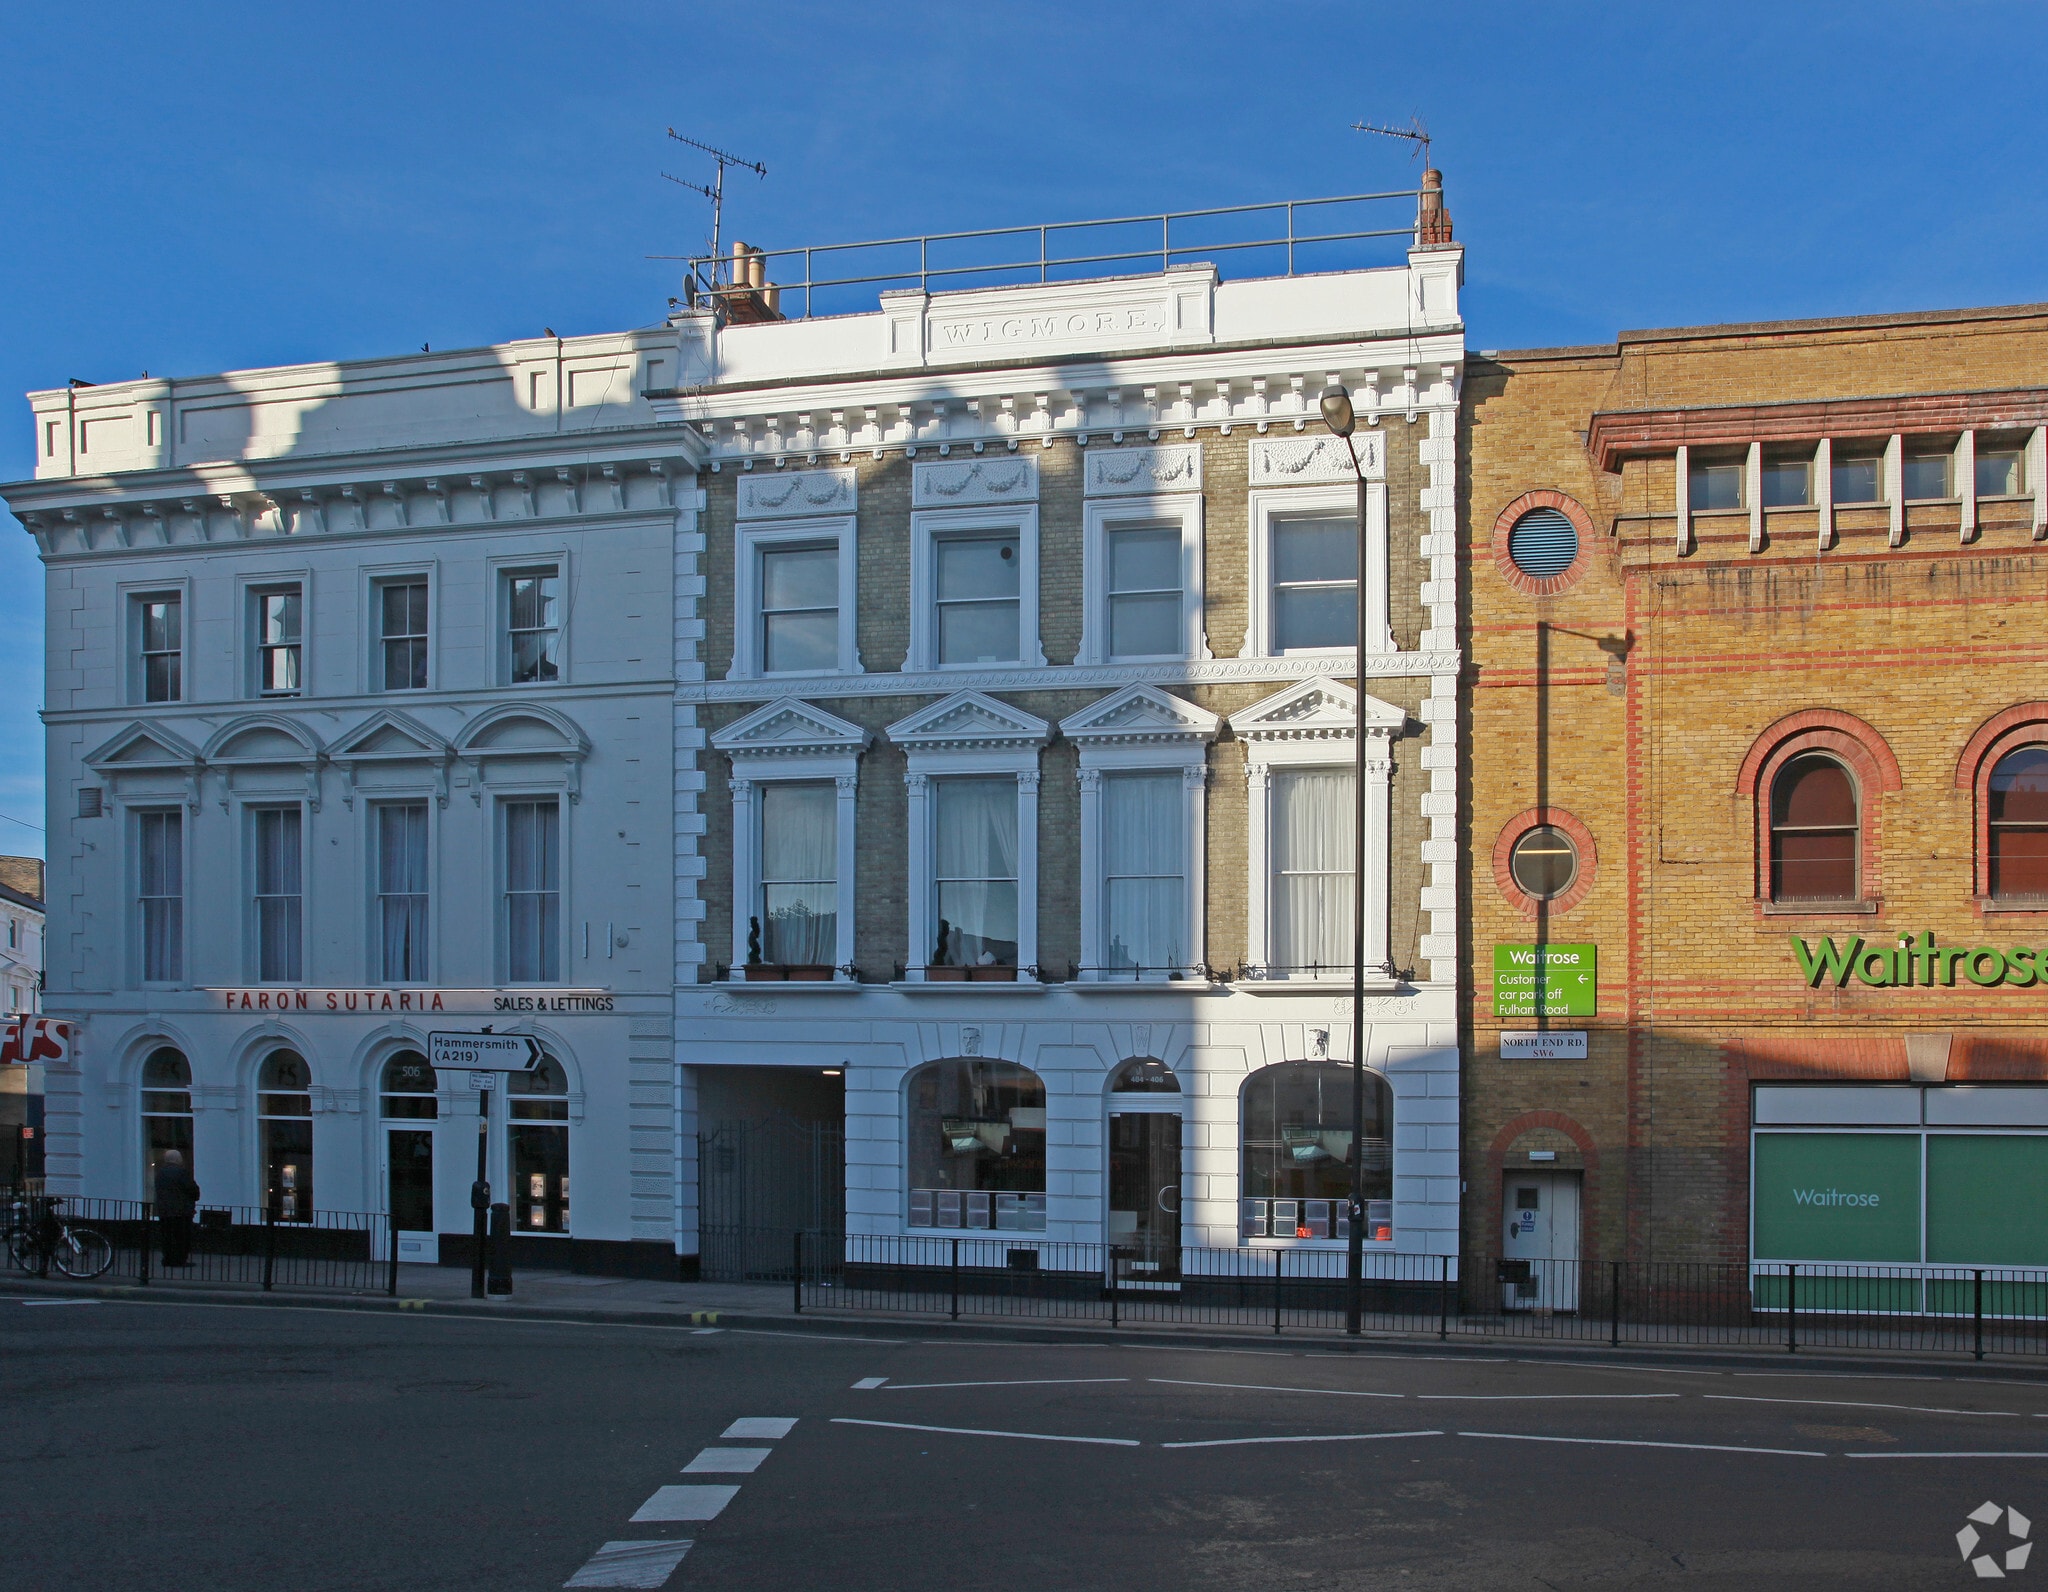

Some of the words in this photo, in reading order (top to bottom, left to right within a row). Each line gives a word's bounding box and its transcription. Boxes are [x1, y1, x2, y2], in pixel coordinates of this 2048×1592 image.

[1509, 950, 1580, 965] Waitrose
[1499, 973, 1551, 985] Customer
[226, 992, 307, 1009] FARON
[326, 992, 444, 1010] SUTARIA
[1499, 991, 1517, 1000] car
[1519, 989, 1545, 1003] park
[1547, 988, 1563, 1000] off
[494, 997, 534, 1011] SALES
[537, 997, 548, 1011] &
[551, 997, 614, 1011] LETTINGS
[1499, 1004, 1538, 1015] Fulham
[1540, 1004, 1569, 1015] Road
[434, 1037, 519, 1050] Hammersmith
[1503, 1038, 1538, 1047] NORTH
[1542, 1038, 1564, 1047] END
[1568, 1038, 1585, 1047] RD.
[435, 1049, 480, 1063] (A219)
[1533, 1049, 1554, 1058] SW6
[402, 1065, 421, 1077] 506
[1793, 1188, 1880, 1207] Waitrose
